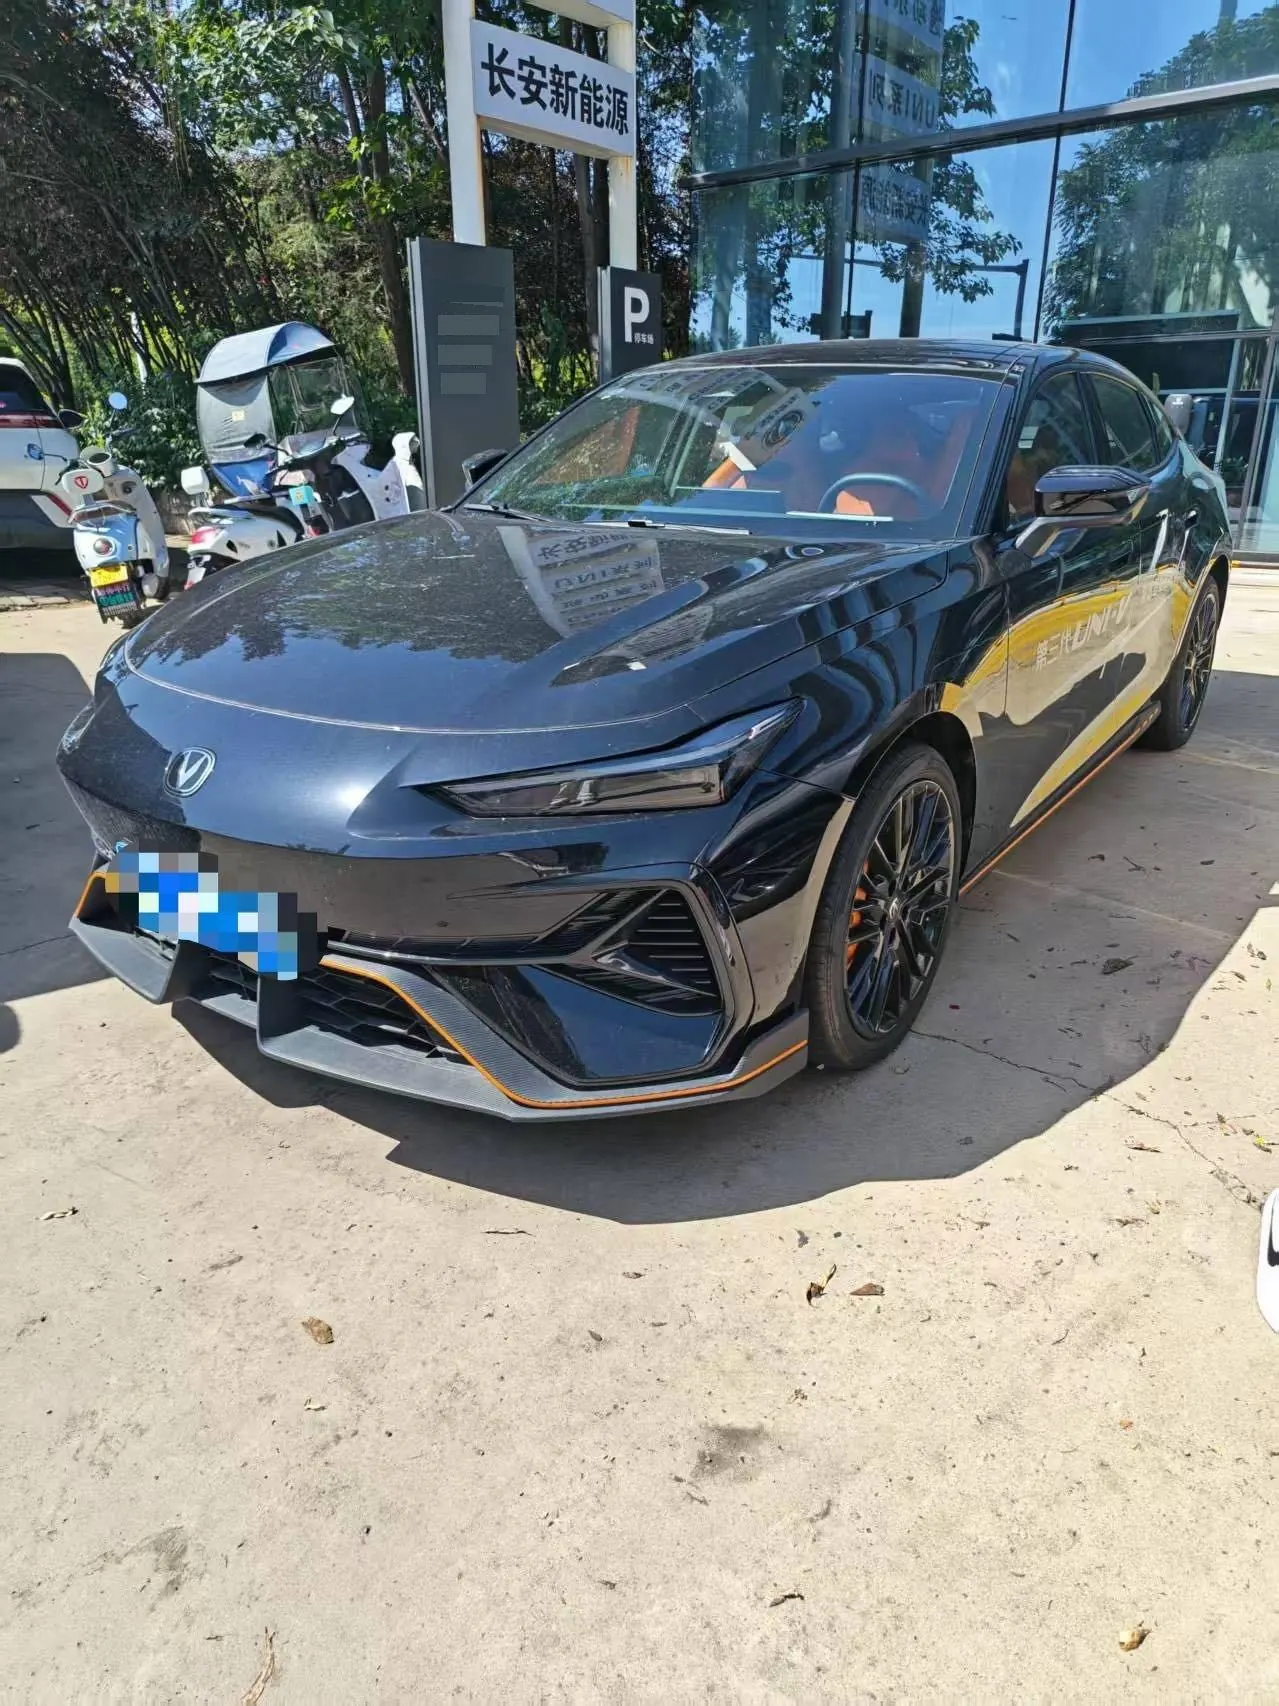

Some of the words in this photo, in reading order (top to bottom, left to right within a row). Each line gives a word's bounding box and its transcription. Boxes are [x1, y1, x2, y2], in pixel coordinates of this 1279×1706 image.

[480, 42, 630, 135] 长安新能源
[624, 286, 650, 343] P
[634, 332, 654, 345] 停车场
